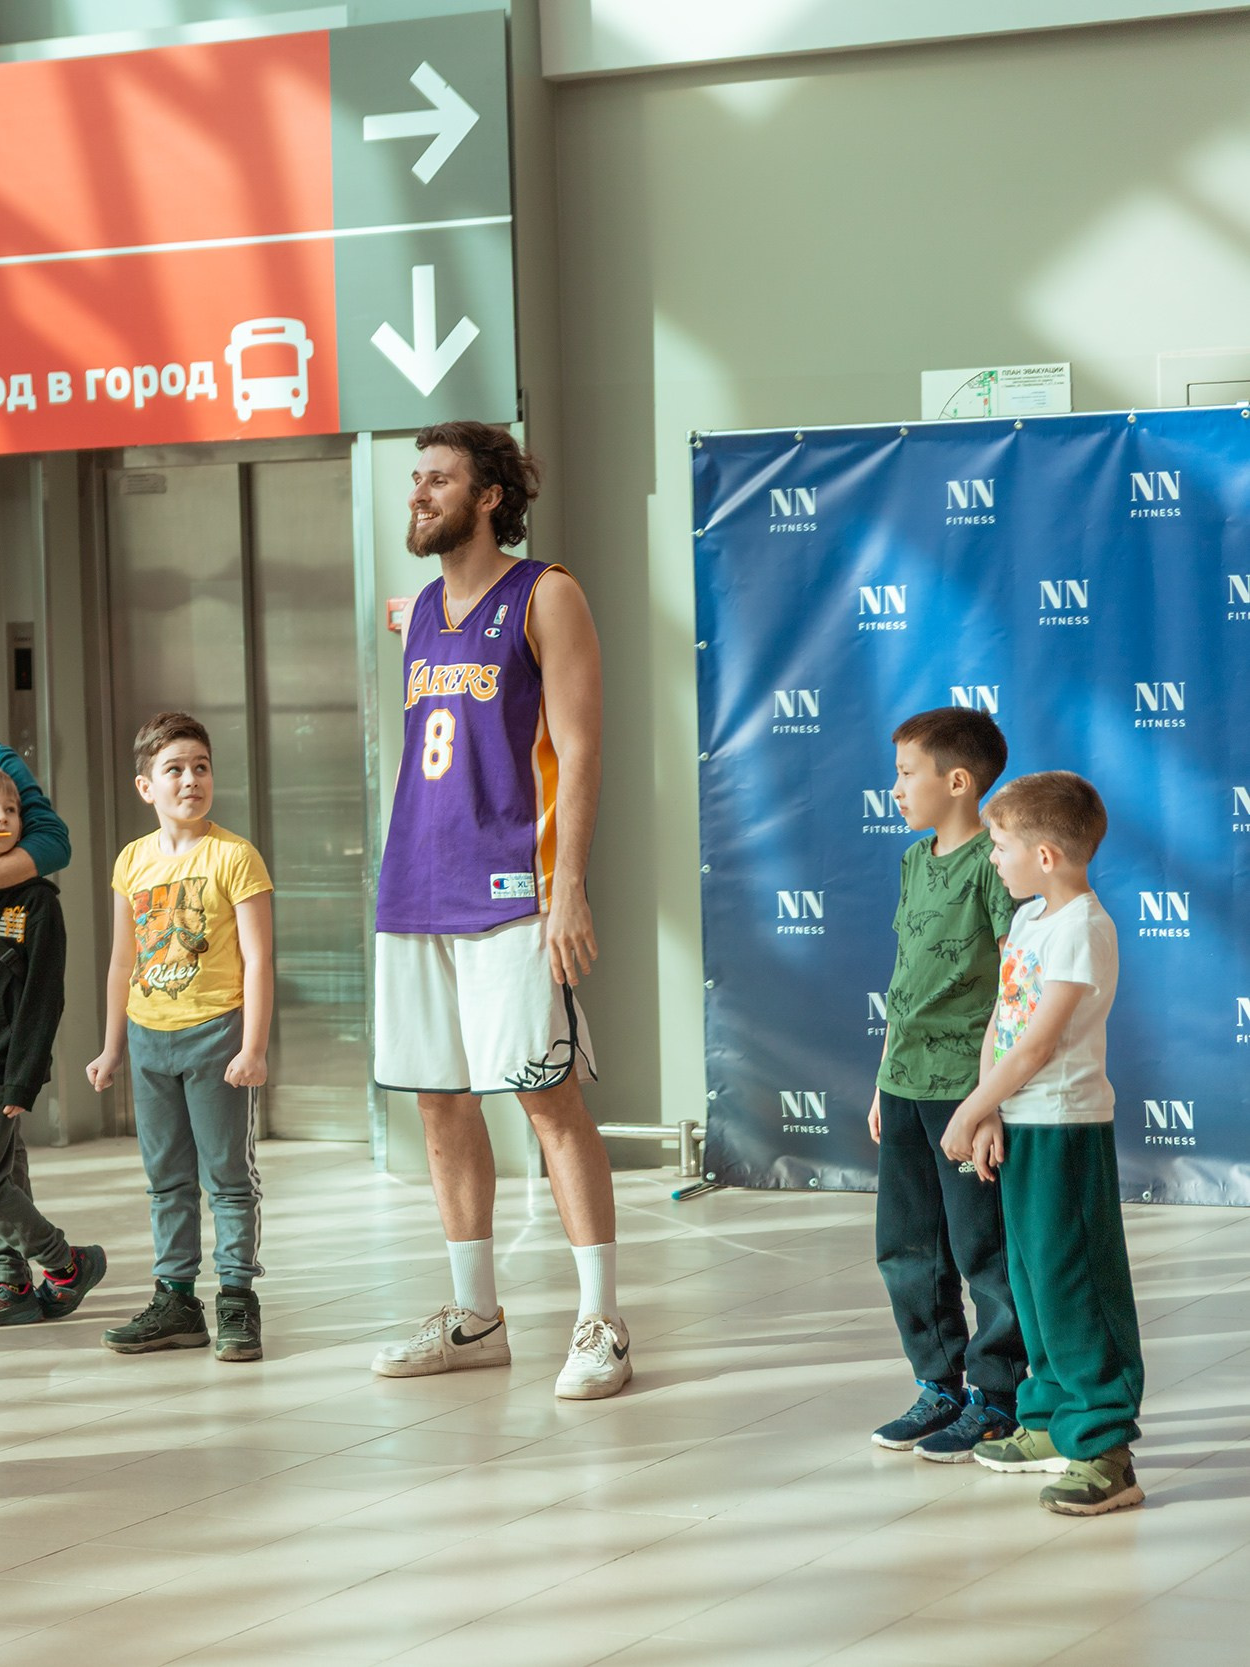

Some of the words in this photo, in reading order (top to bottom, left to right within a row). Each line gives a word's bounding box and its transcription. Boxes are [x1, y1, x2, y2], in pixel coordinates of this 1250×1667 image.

[47, 372, 73, 404] в
[85, 361, 218, 409] город
[1023, 366, 1064, 375] ЭВАКУАЦИИ
[946, 479, 995, 510] NN
[1131, 470, 1181, 502] NN
[769, 487, 817, 517] NN
[1130, 507, 1181, 518] FITNESS
[769, 522, 817, 533] FITNESS
[945, 515, 995, 526] FITNESS
[858, 584, 907, 615] NN
[1039, 579, 1089, 610] NN
[1228, 574, 1250, 604] N
[858, 620, 907, 631] FITNESS
[1039, 616, 1090, 626] FITNESS
[404, 658, 502, 710] LAKERS
[1134, 681, 1186, 712] NN
[773, 689, 820, 718] NN
[772, 725, 820, 734] FITNESS
[1134, 718, 1186, 728] FITNESS
[421, 708, 456, 780] 8
[862, 825, 911, 834] FITNESS
[133, 877, 208, 919] BMX
[776, 890, 824, 919] NN
[1138, 891, 1190, 921] NN
[776, 926, 825, 935] FITNESS
[1139, 927, 1190, 938] FITNESS
[144, 962, 200, 989] Rider
[779, 1090, 826, 1119] NN
[1144, 1100, 1195, 1130] NN
[783, 1124, 830, 1134] FITNESS
[1145, 1136, 1196, 1146] FITNESS
